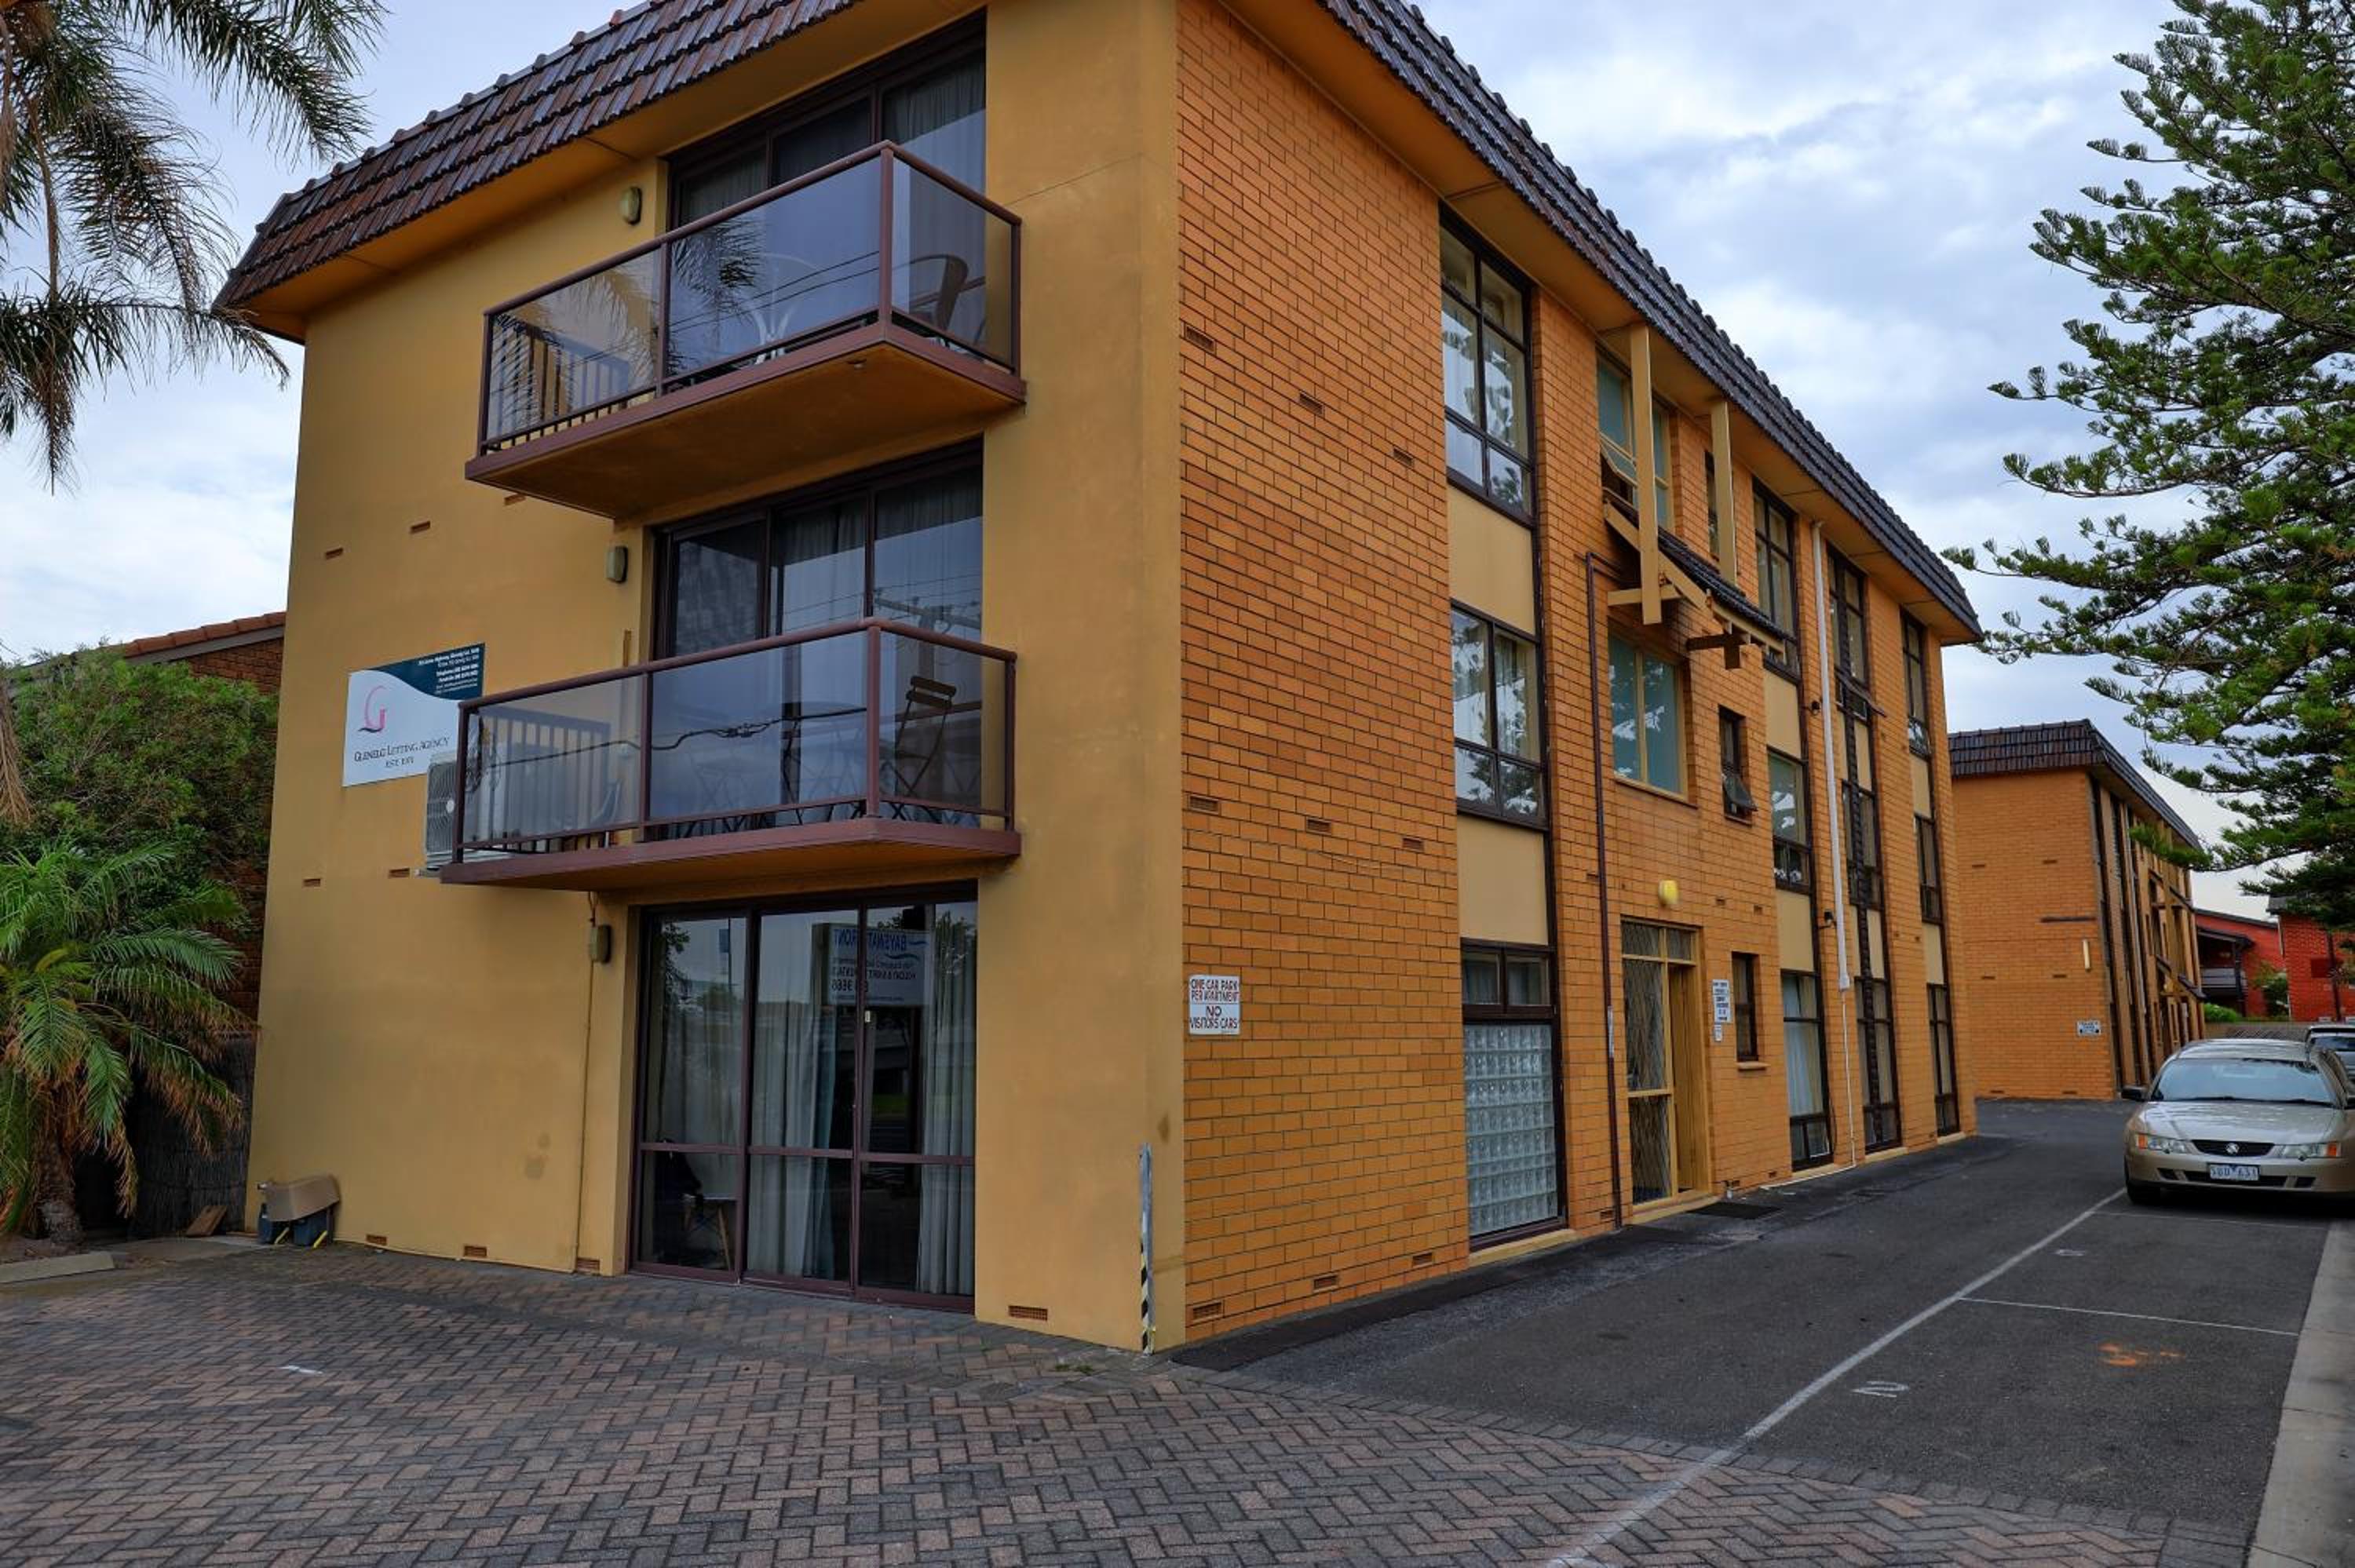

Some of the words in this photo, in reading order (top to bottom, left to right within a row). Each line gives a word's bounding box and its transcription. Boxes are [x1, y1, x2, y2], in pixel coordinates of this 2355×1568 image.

[1191, 979, 1205, 990] ONE
[1207, 979, 1219, 990] CAR
[1221, 979, 1238, 990] PARK
[1191, 990, 1203, 1001] PER
[1204, 990, 1240, 1002] APARTMENT
[1206, 1005, 1222, 1017] NO
[1190, 1016, 1219, 1029] VISITORS
[1220, 1017, 1238, 1029] CARS
